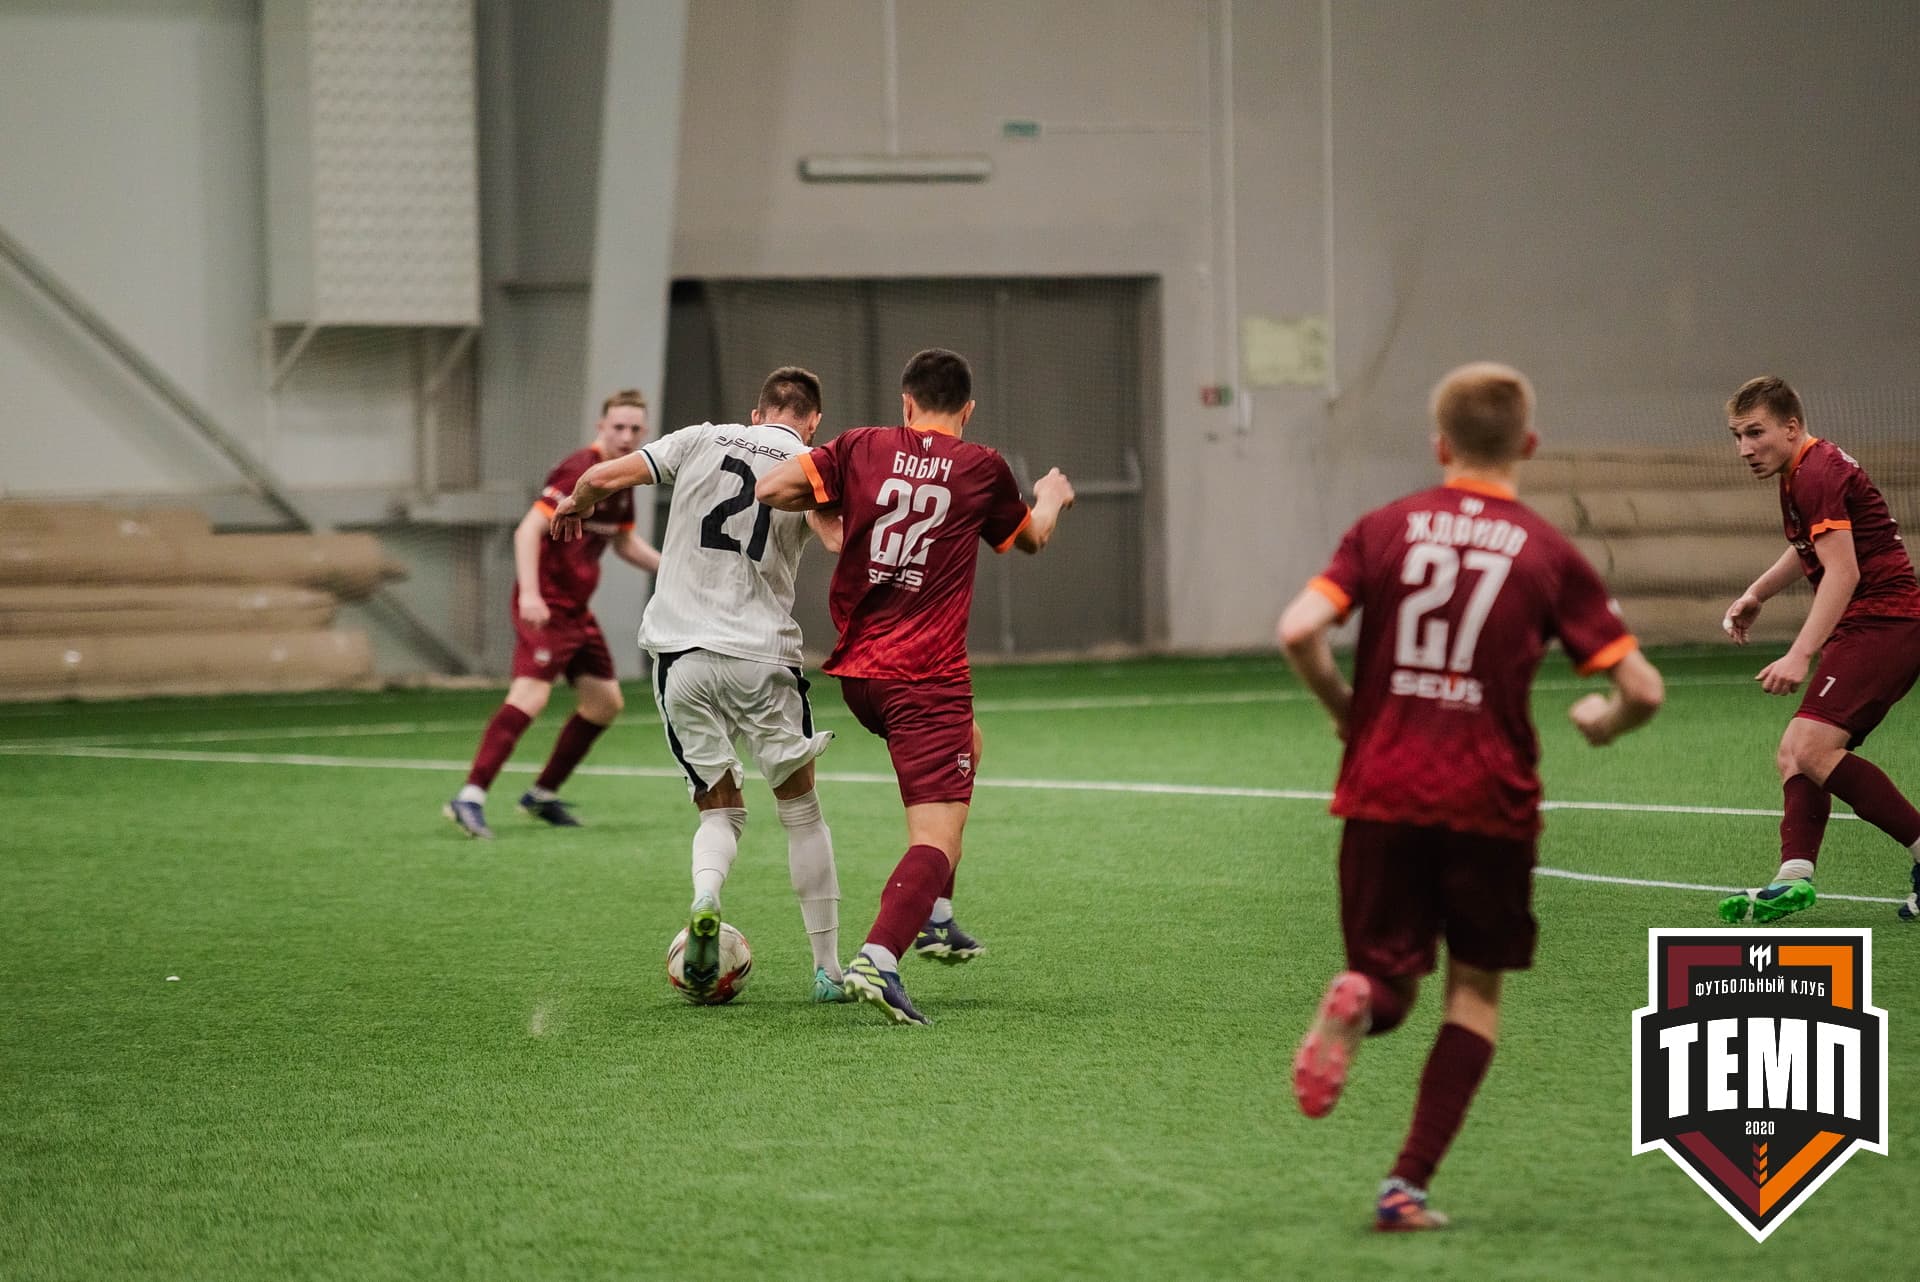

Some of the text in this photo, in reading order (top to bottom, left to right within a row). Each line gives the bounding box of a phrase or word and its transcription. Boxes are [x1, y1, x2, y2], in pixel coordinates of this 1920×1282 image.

[892, 450, 953, 482] БАБИЧ
[870, 477, 952, 567] 22
[1394, 542, 1514, 673] 27
